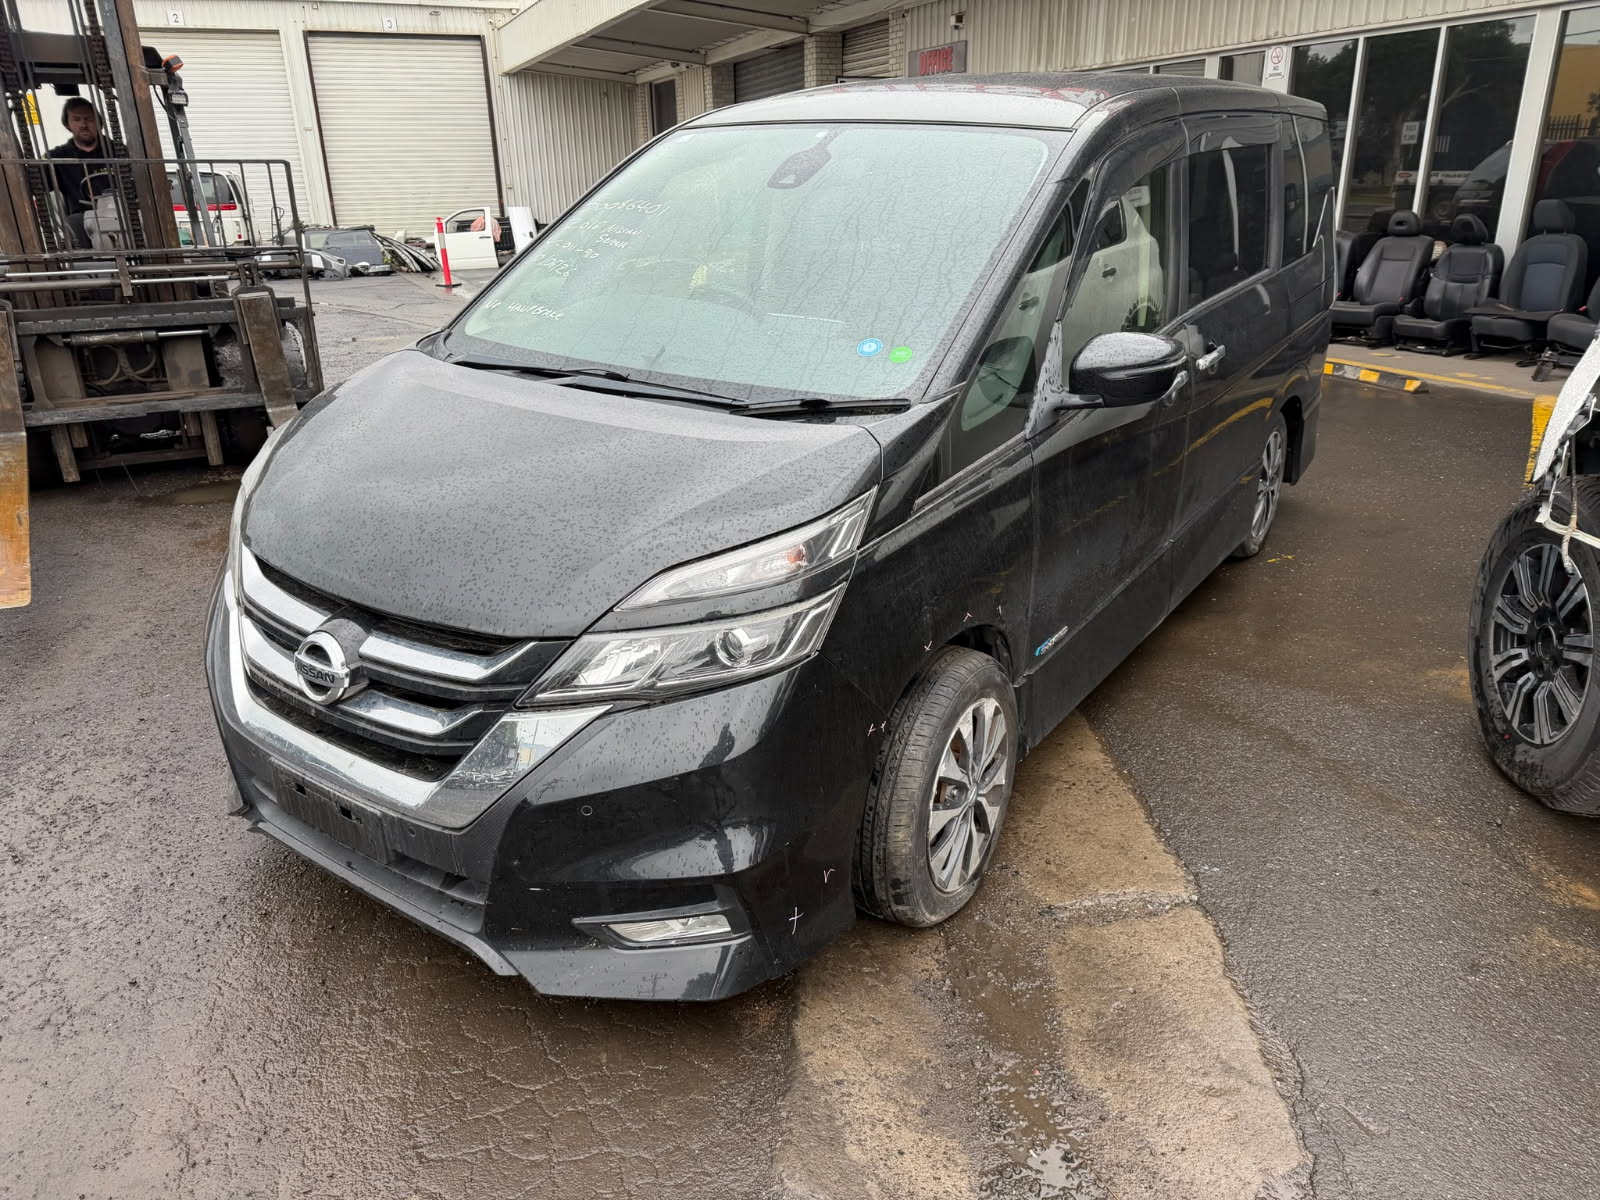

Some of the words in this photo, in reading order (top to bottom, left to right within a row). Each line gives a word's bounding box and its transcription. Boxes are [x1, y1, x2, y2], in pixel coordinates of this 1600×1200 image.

[172, 13, 180, 23] 2
[386, 19, 393, 29] 3
[918, 46, 954, 76] OFFICE
[296, 660, 336, 684] NISSAN
